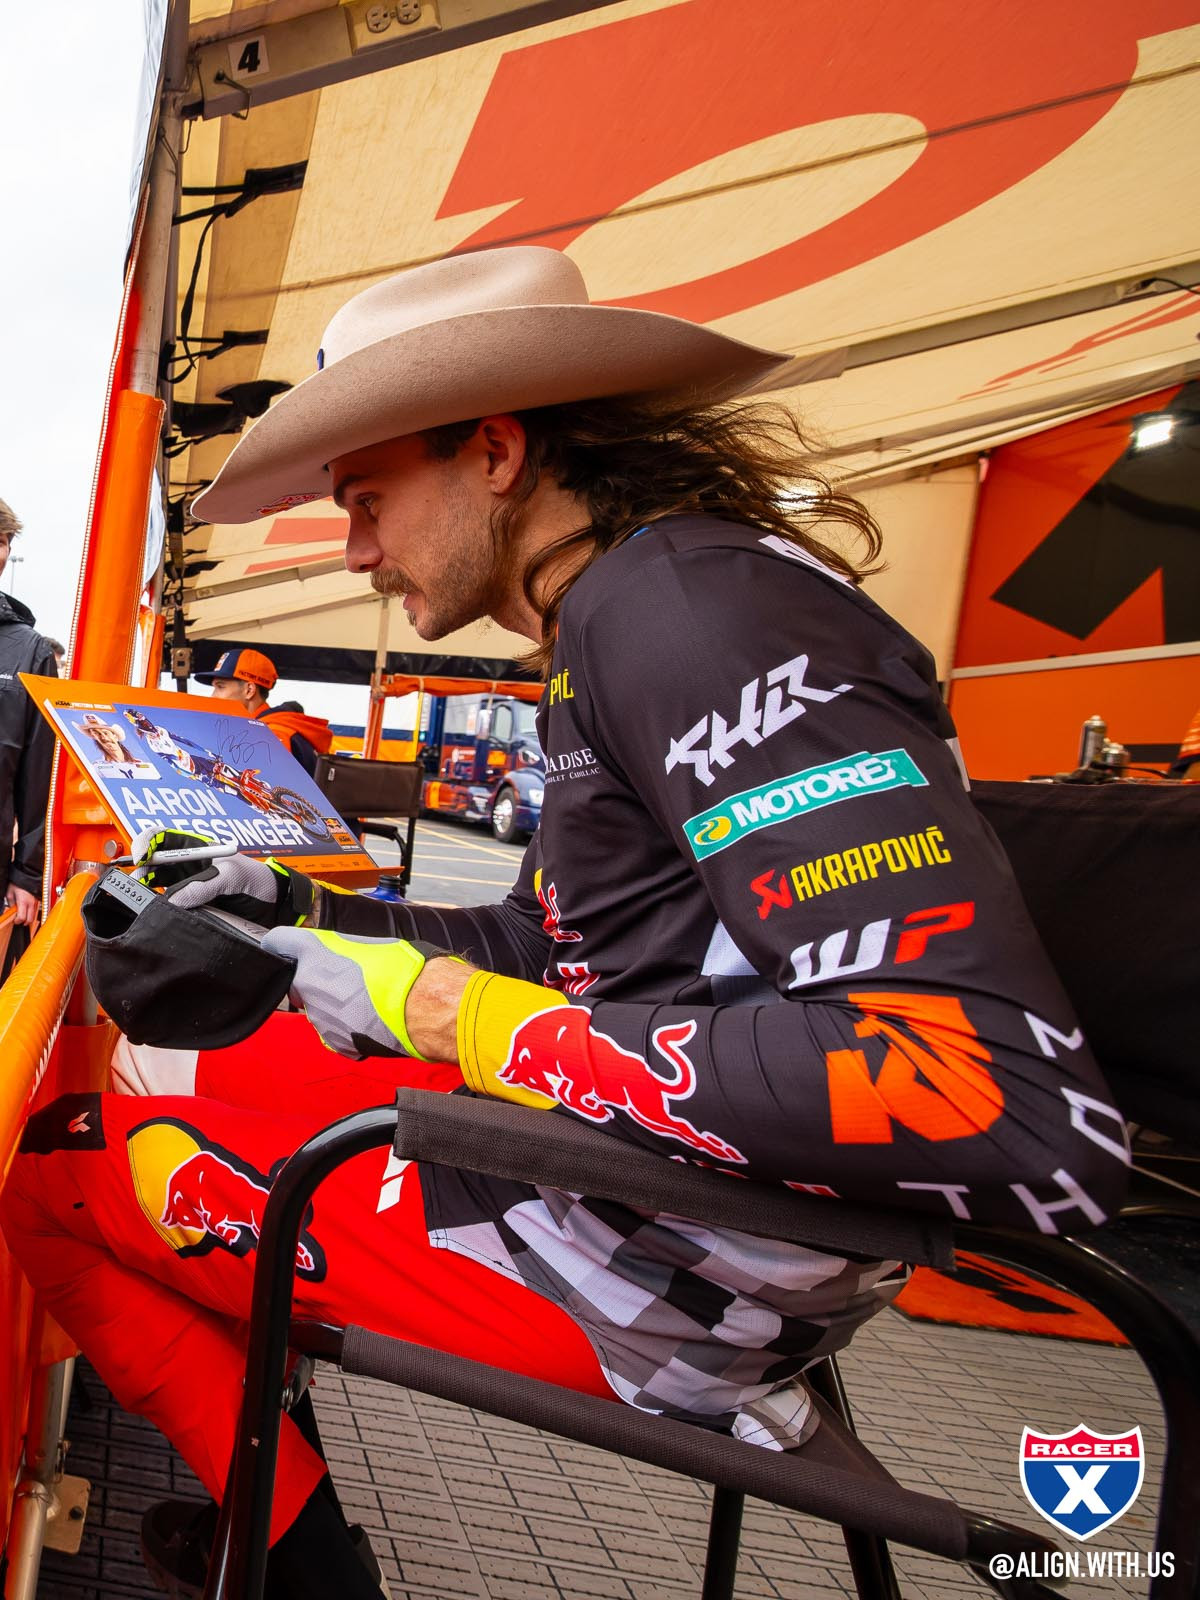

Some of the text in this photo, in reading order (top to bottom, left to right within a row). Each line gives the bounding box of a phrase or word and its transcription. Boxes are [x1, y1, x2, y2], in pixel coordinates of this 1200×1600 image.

[238, 41, 260, 73] 4
[122, 786, 227, 816] AARON
[730, 756, 897, 827] MOTOREX
[135, 818, 313, 847] PSSINGER
[787, 901, 976, 990] WP
